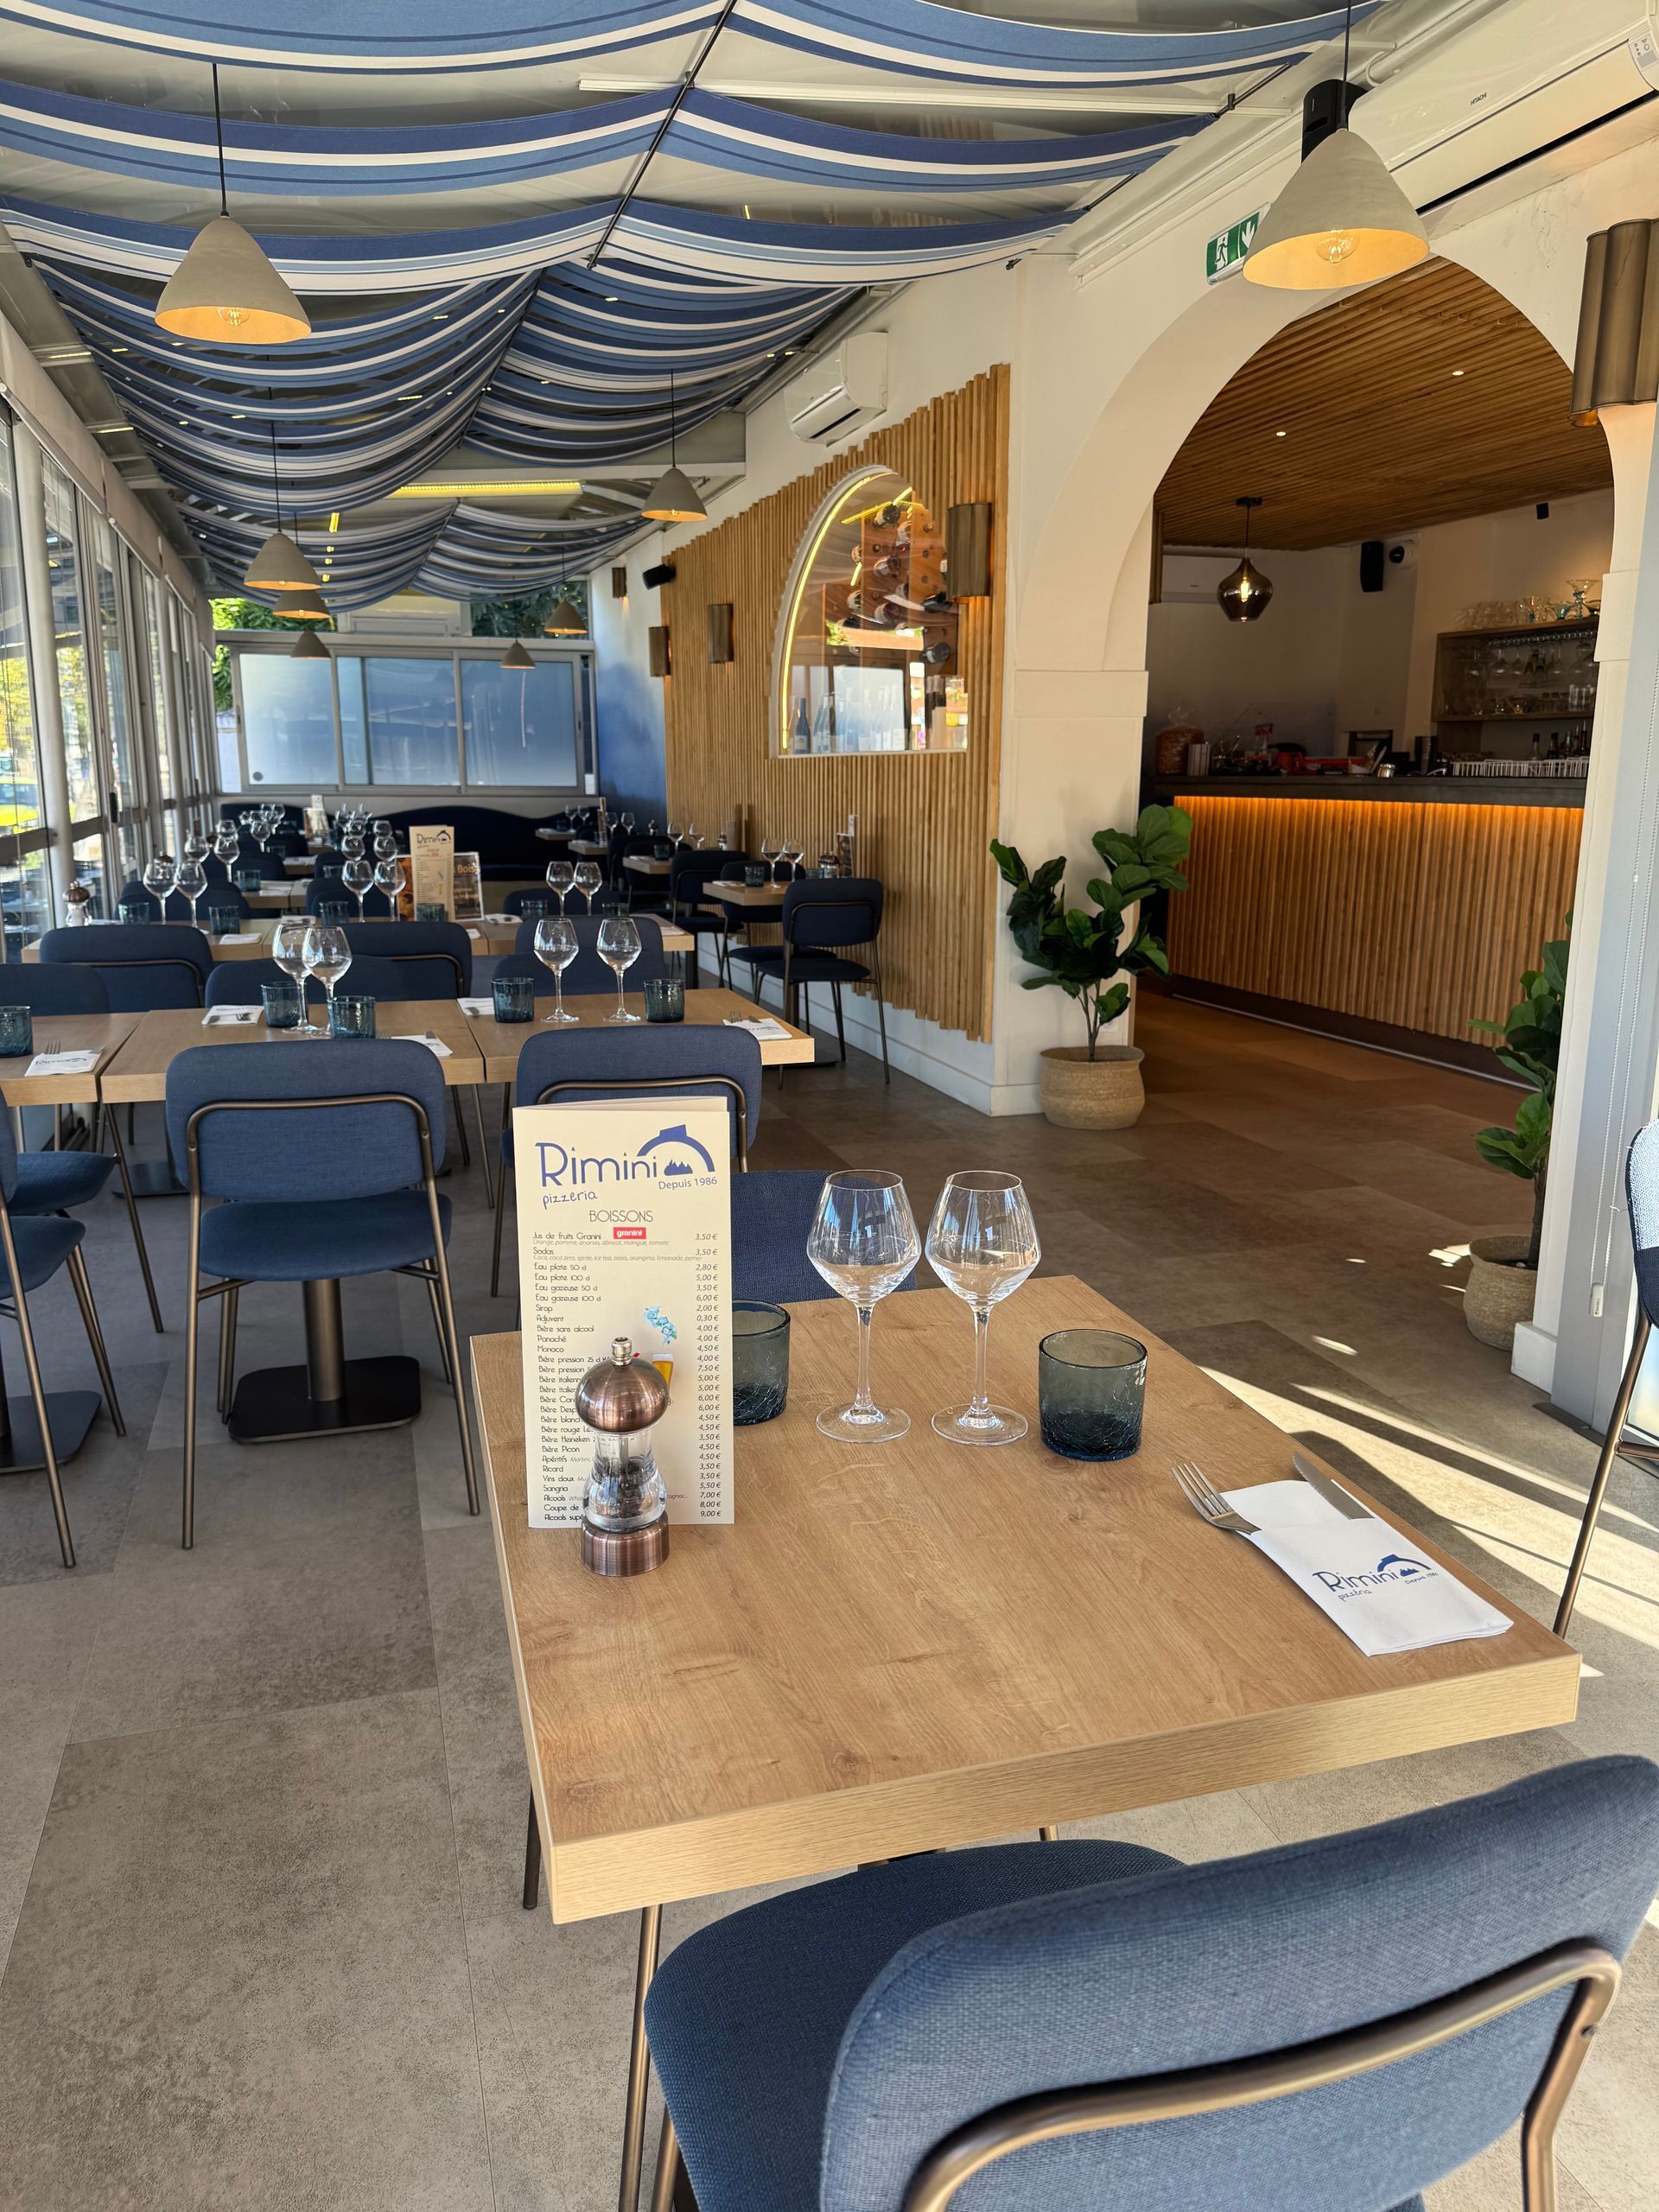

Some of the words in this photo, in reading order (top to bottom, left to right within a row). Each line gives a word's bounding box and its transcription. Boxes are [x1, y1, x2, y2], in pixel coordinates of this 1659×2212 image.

[535, 1142, 657, 1187] Rimini
[658, 1179, 692, 1191] Depuis
[695, 1176, 718, 1186] 1986
[543, 1191, 598, 1211] pizzeria
[588, 1210, 653, 1222] BOISSONS
[616, 1230, 643, 1238] granini
[550, 1263, 568, 1272] plate
[550, 1274, 568, 1282] plate
[536, 1304, 553, 1313] Sirop
[557, 1356, 584, 1364] pression
[558, 1366, 585, 1375] pression
[542, 1455, 567, 1464] Apéritifs
[543, 1484, 568, 1493] Sangria
[1313, 1568, 1399, 1592] Rimini
